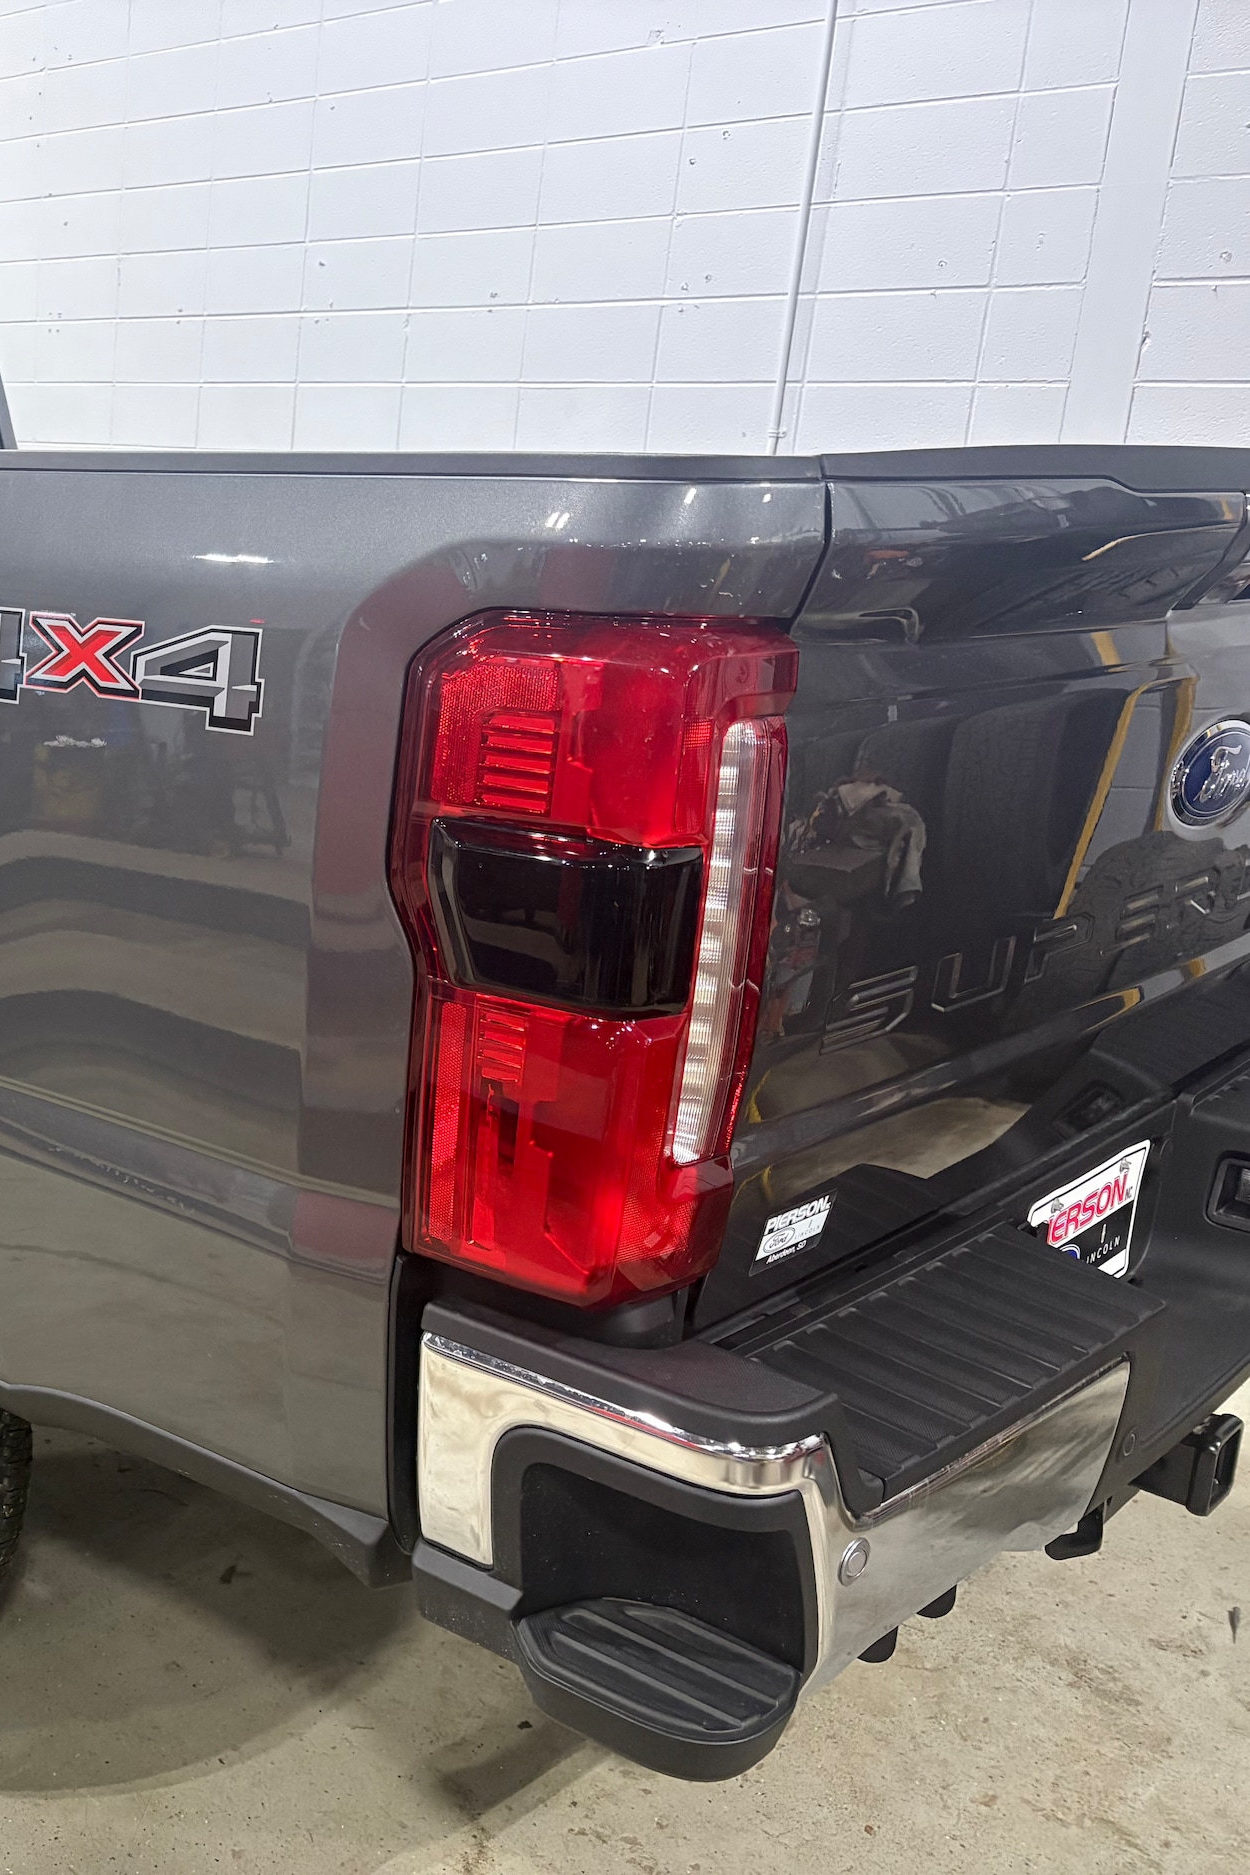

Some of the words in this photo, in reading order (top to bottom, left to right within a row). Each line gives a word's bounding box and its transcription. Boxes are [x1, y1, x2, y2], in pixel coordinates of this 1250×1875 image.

[819, 866, 1221, 1055] SUPER
[763, 1194, 831, 1236] PIERSON
[1046, 1171, 1129, 1247] IERSON
[1085, 1234, 1121, 1264] INCOLN
